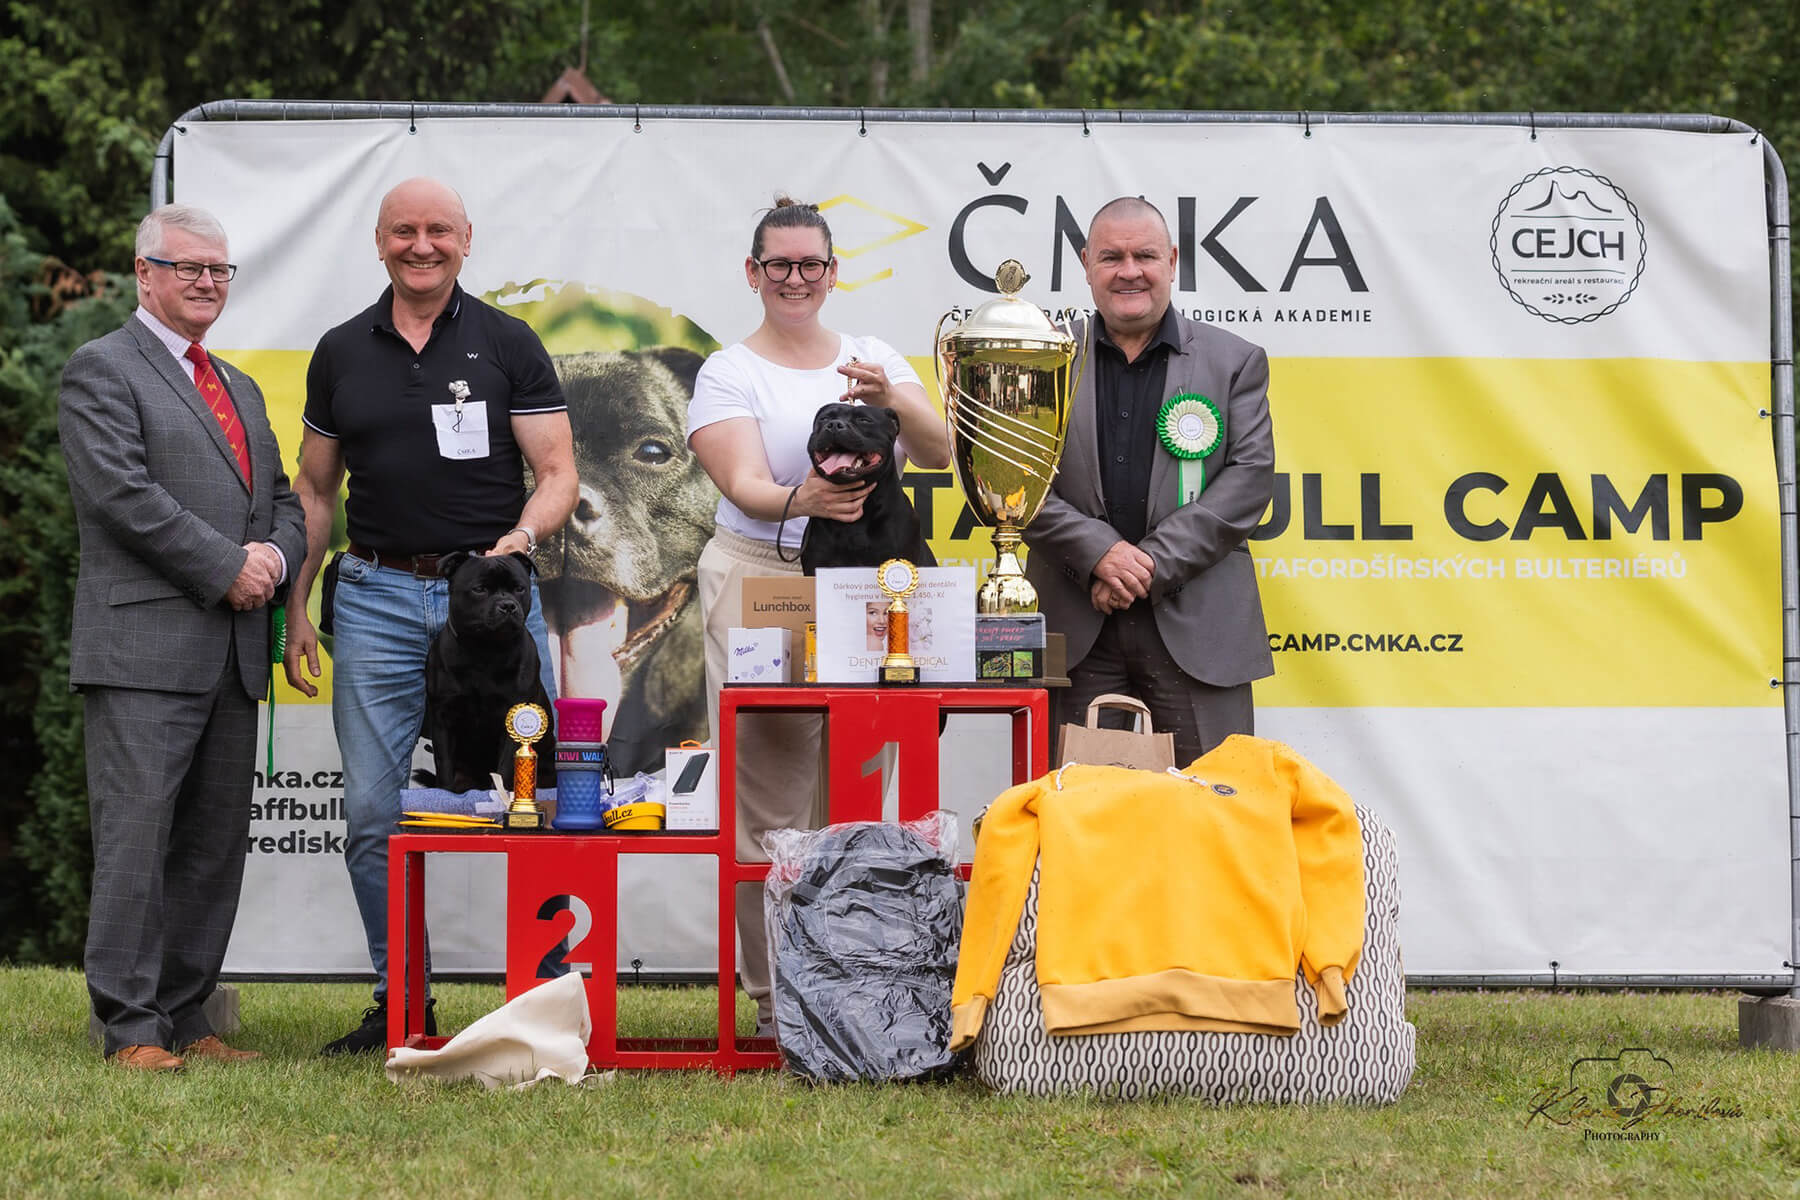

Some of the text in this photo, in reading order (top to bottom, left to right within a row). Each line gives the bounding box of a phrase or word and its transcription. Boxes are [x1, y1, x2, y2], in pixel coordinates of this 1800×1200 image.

[1511, 228, 1624, 261] CEJCH
[1274, 310, 1372, 322] AKADEMIE
[1443, 472, 1744, 542] CAMP
[1515, 552, 1687, 579] BULTERIÉRŮ
[753, 601, 811, 612] Lunchbox
[733, 644, 757, 656] Milka
[1268, 633, 1464, 652] CAMP.CMKA.CZ
[558, 751, 579, 761] KIWI
[861, 741, 899, 822] 1
[536, 894, 592, 978] 2
